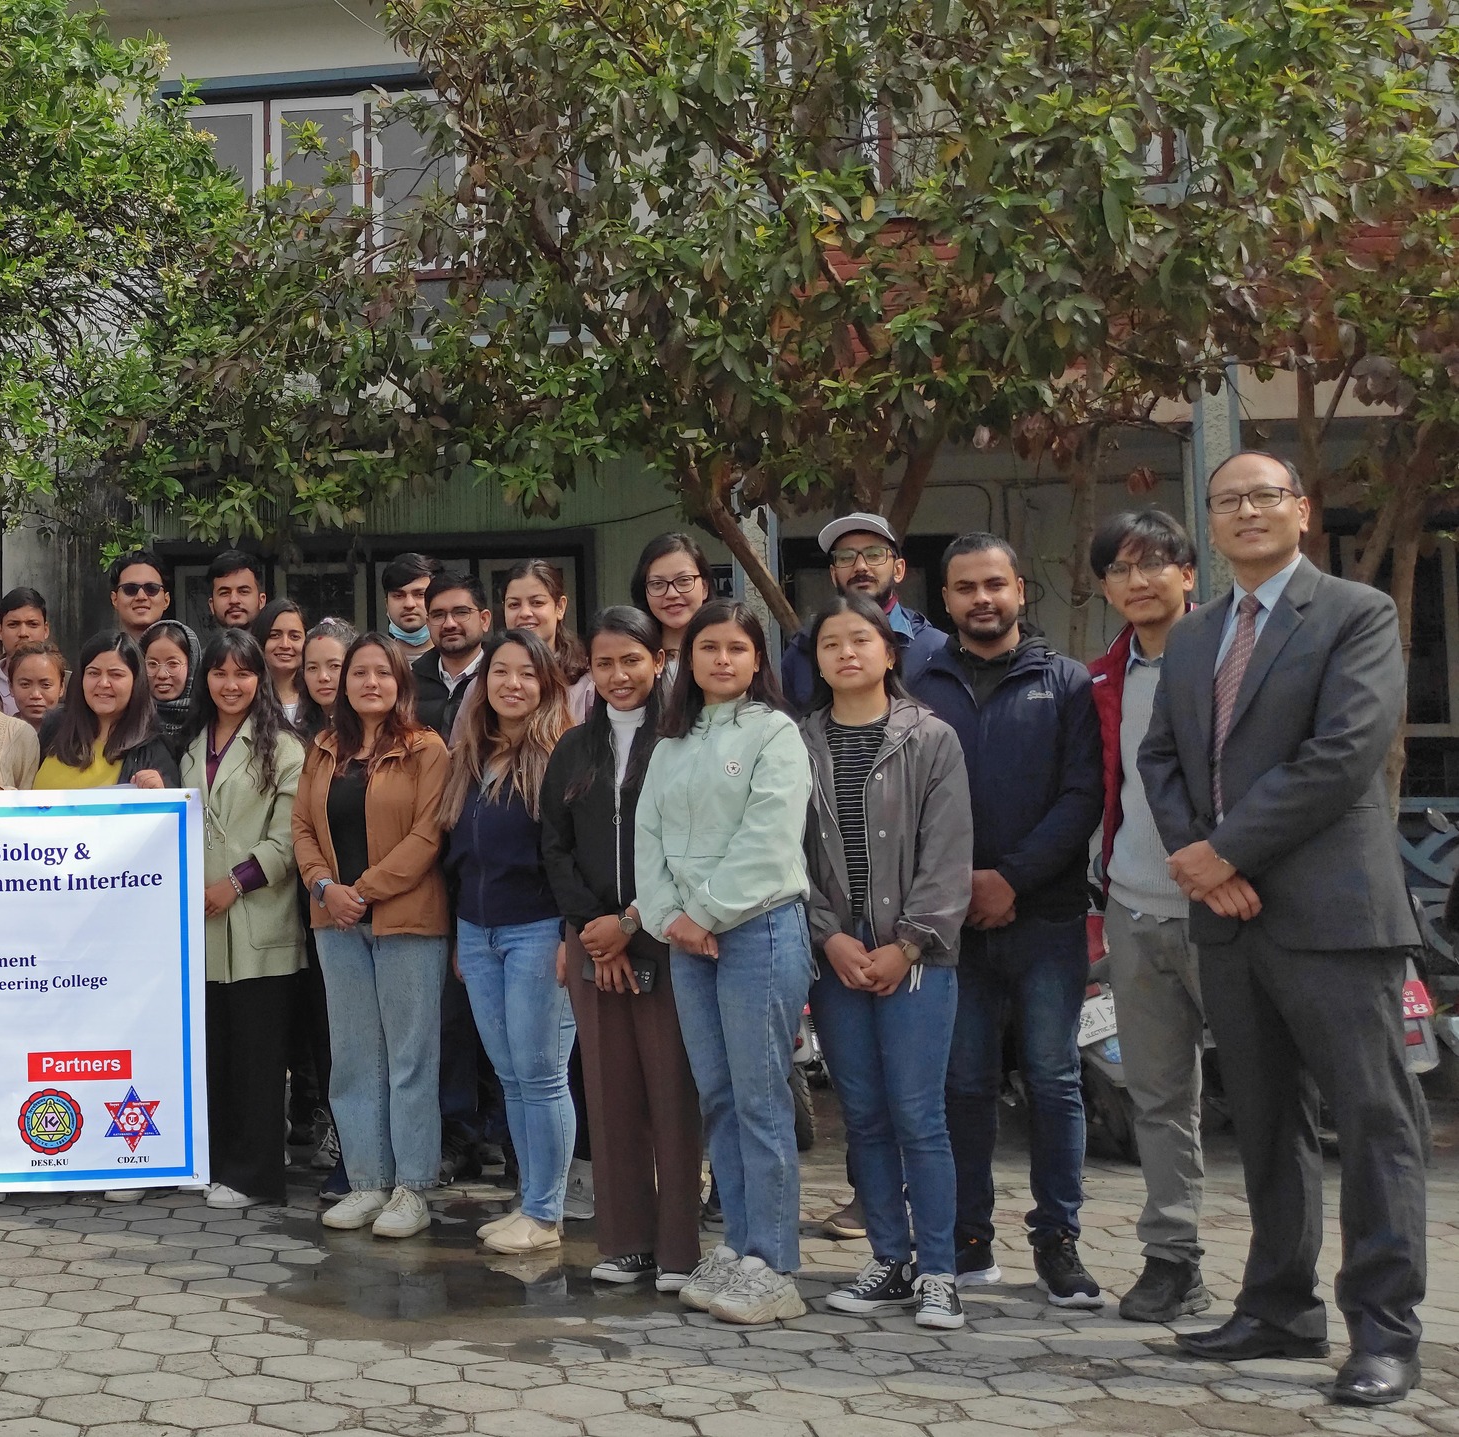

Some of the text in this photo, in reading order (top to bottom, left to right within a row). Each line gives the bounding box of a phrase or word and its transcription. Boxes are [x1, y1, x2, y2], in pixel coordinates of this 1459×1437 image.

[74, 842, 91, 860] &
[67, 870, 163, 891] Interface
[52, 974, 108, 991] College
[42, 1057, 121, 1073] Partners
[30, 1158, 69, 1167] DESE,KU
[117, 1155, 150, 1164] CDZ,TU
